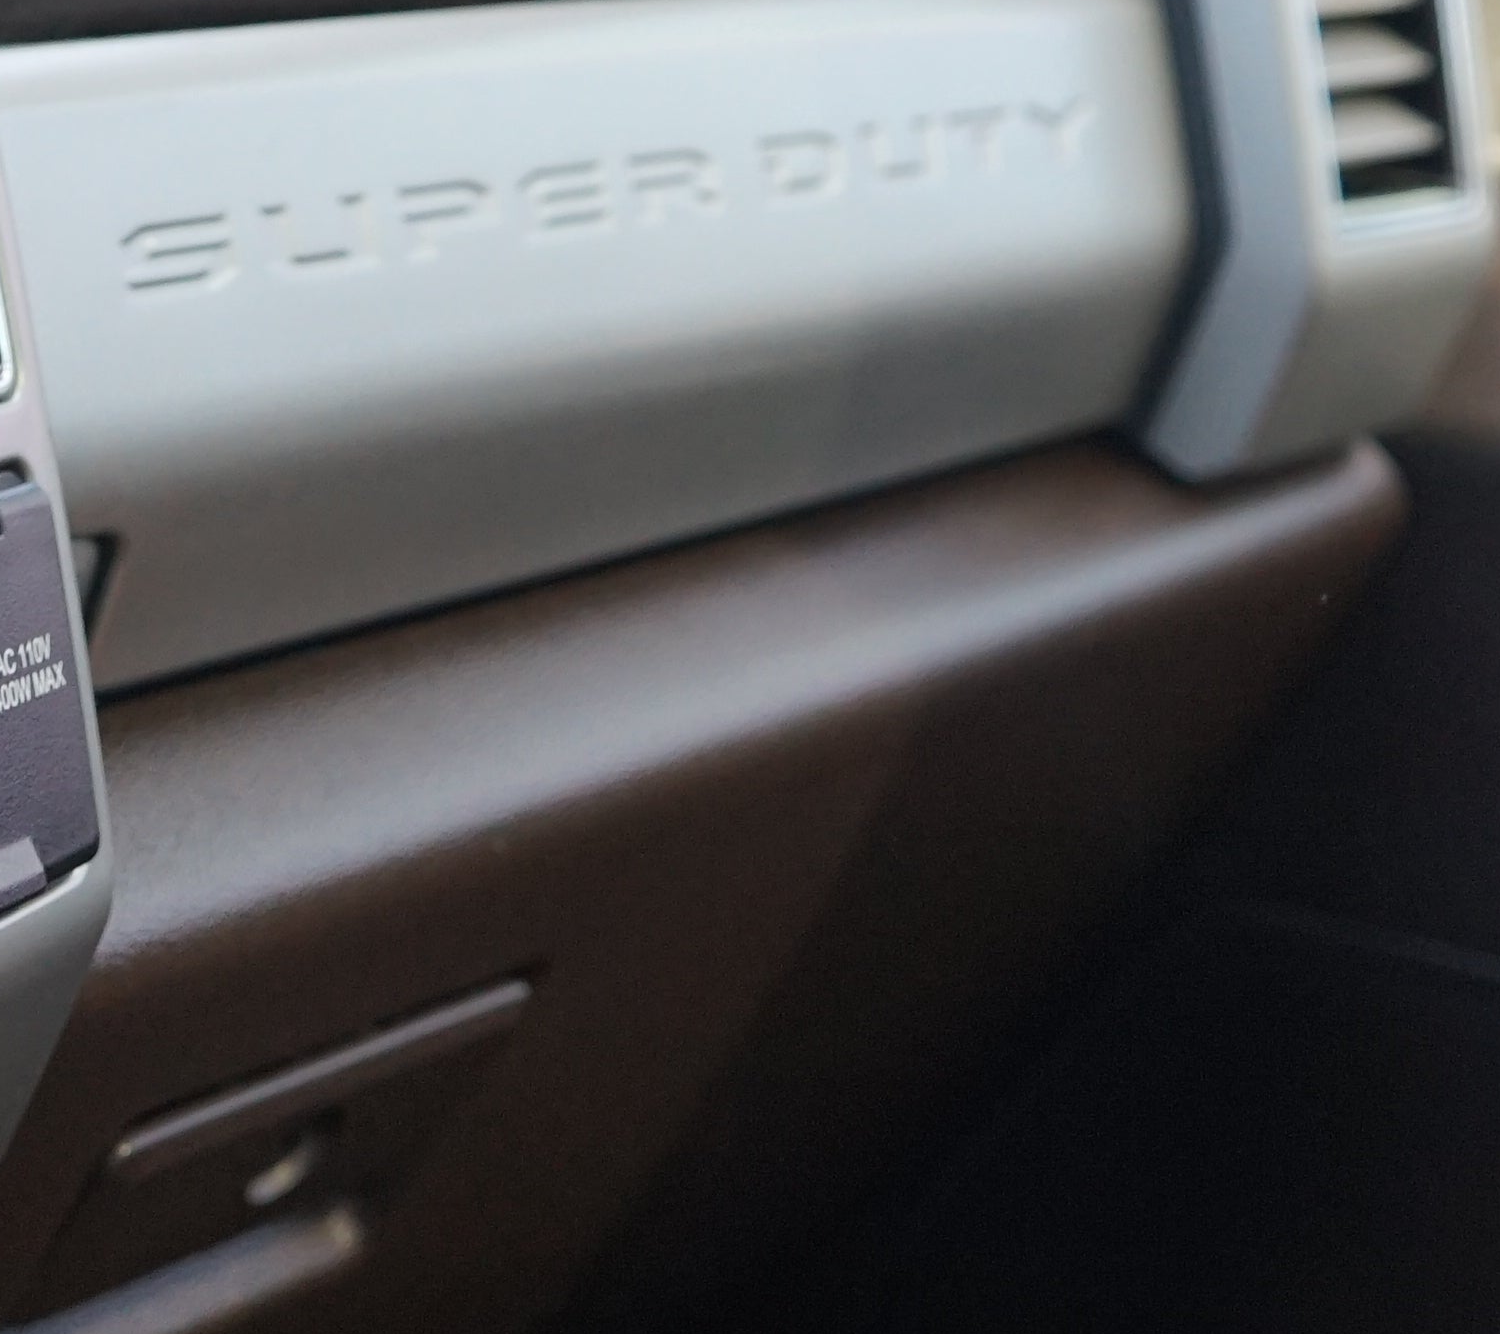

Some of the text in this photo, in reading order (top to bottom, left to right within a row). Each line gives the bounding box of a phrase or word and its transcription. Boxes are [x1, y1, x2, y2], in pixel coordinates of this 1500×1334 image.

[118, 91, 1097, 297] SUPER DUTY
[18, 633, 51, 668] 110V
[31, 662, 67, 697] MAX
